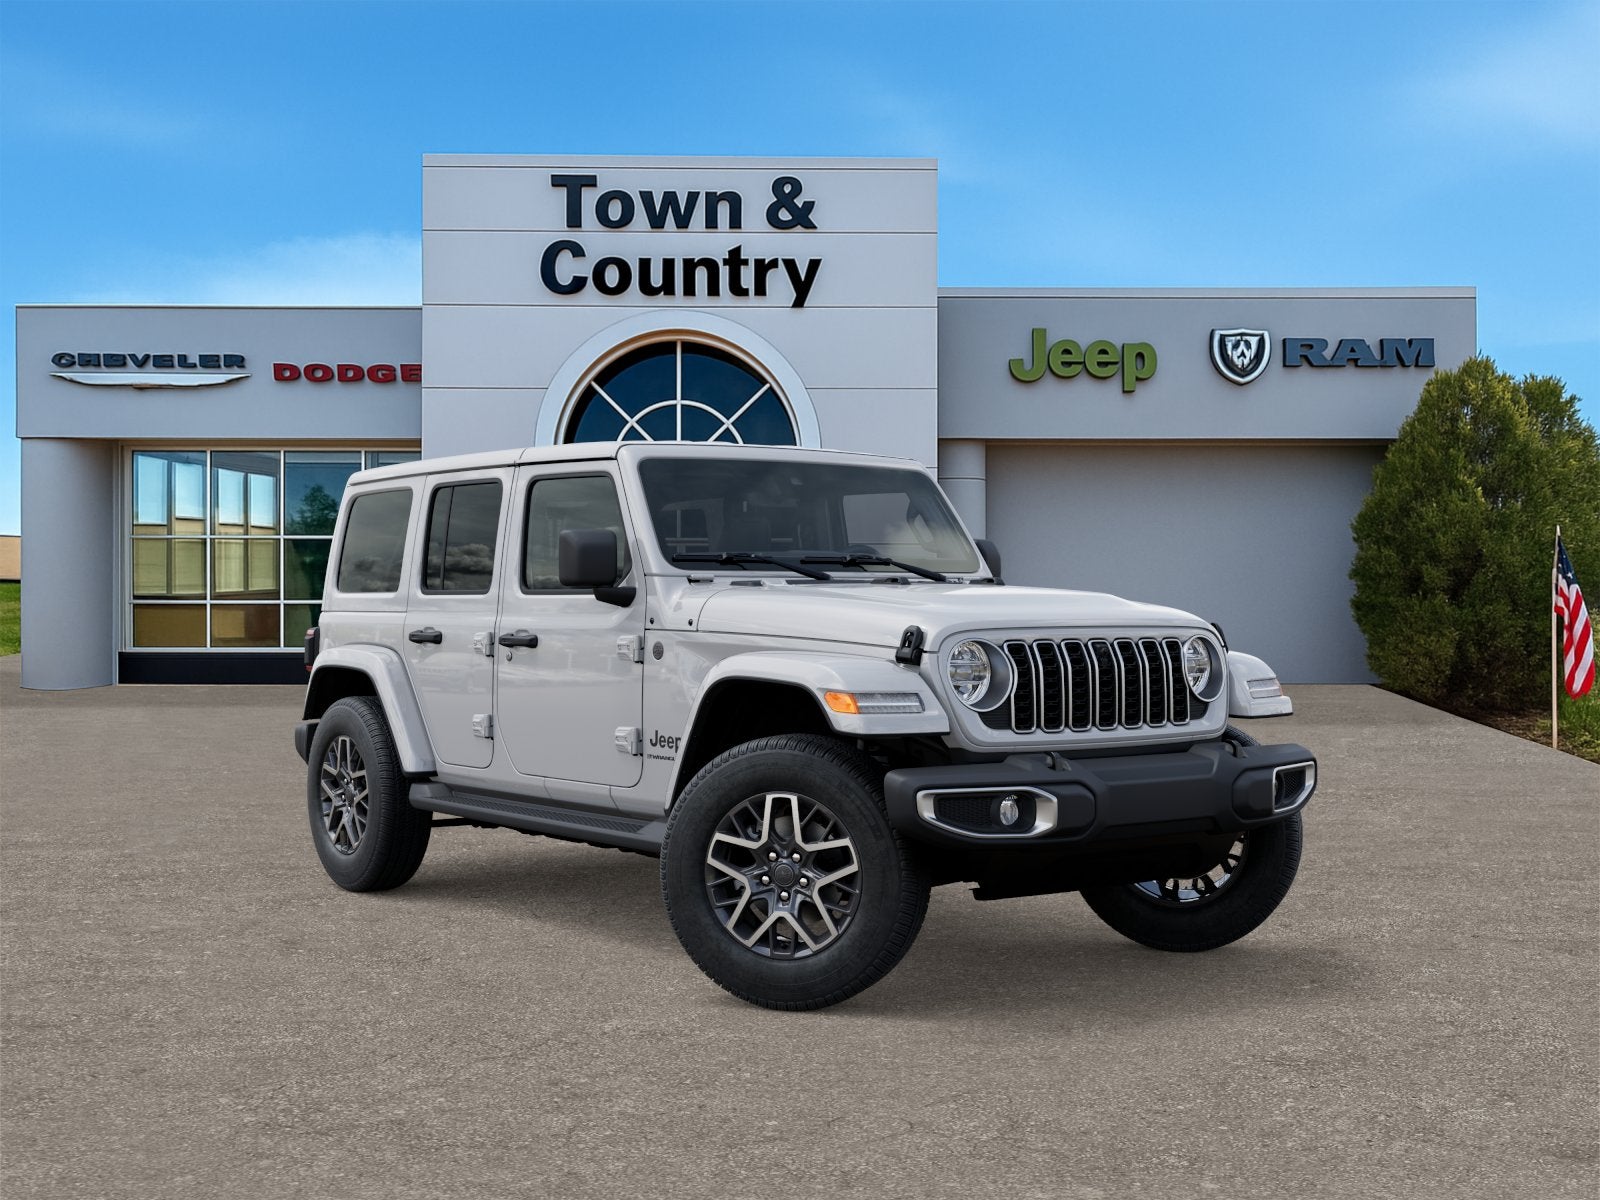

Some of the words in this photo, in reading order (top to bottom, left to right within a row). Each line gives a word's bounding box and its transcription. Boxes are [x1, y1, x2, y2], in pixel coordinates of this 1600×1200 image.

[550, 174, 742, 229] Town
[765, 176, 818, 229] &
[540, 239, 822, 308] Country
[273, 363, 422, 383] DODGE
[1008, 328, 1158, 393] Jeep
[1282, 337, 1436, 368] RAM
